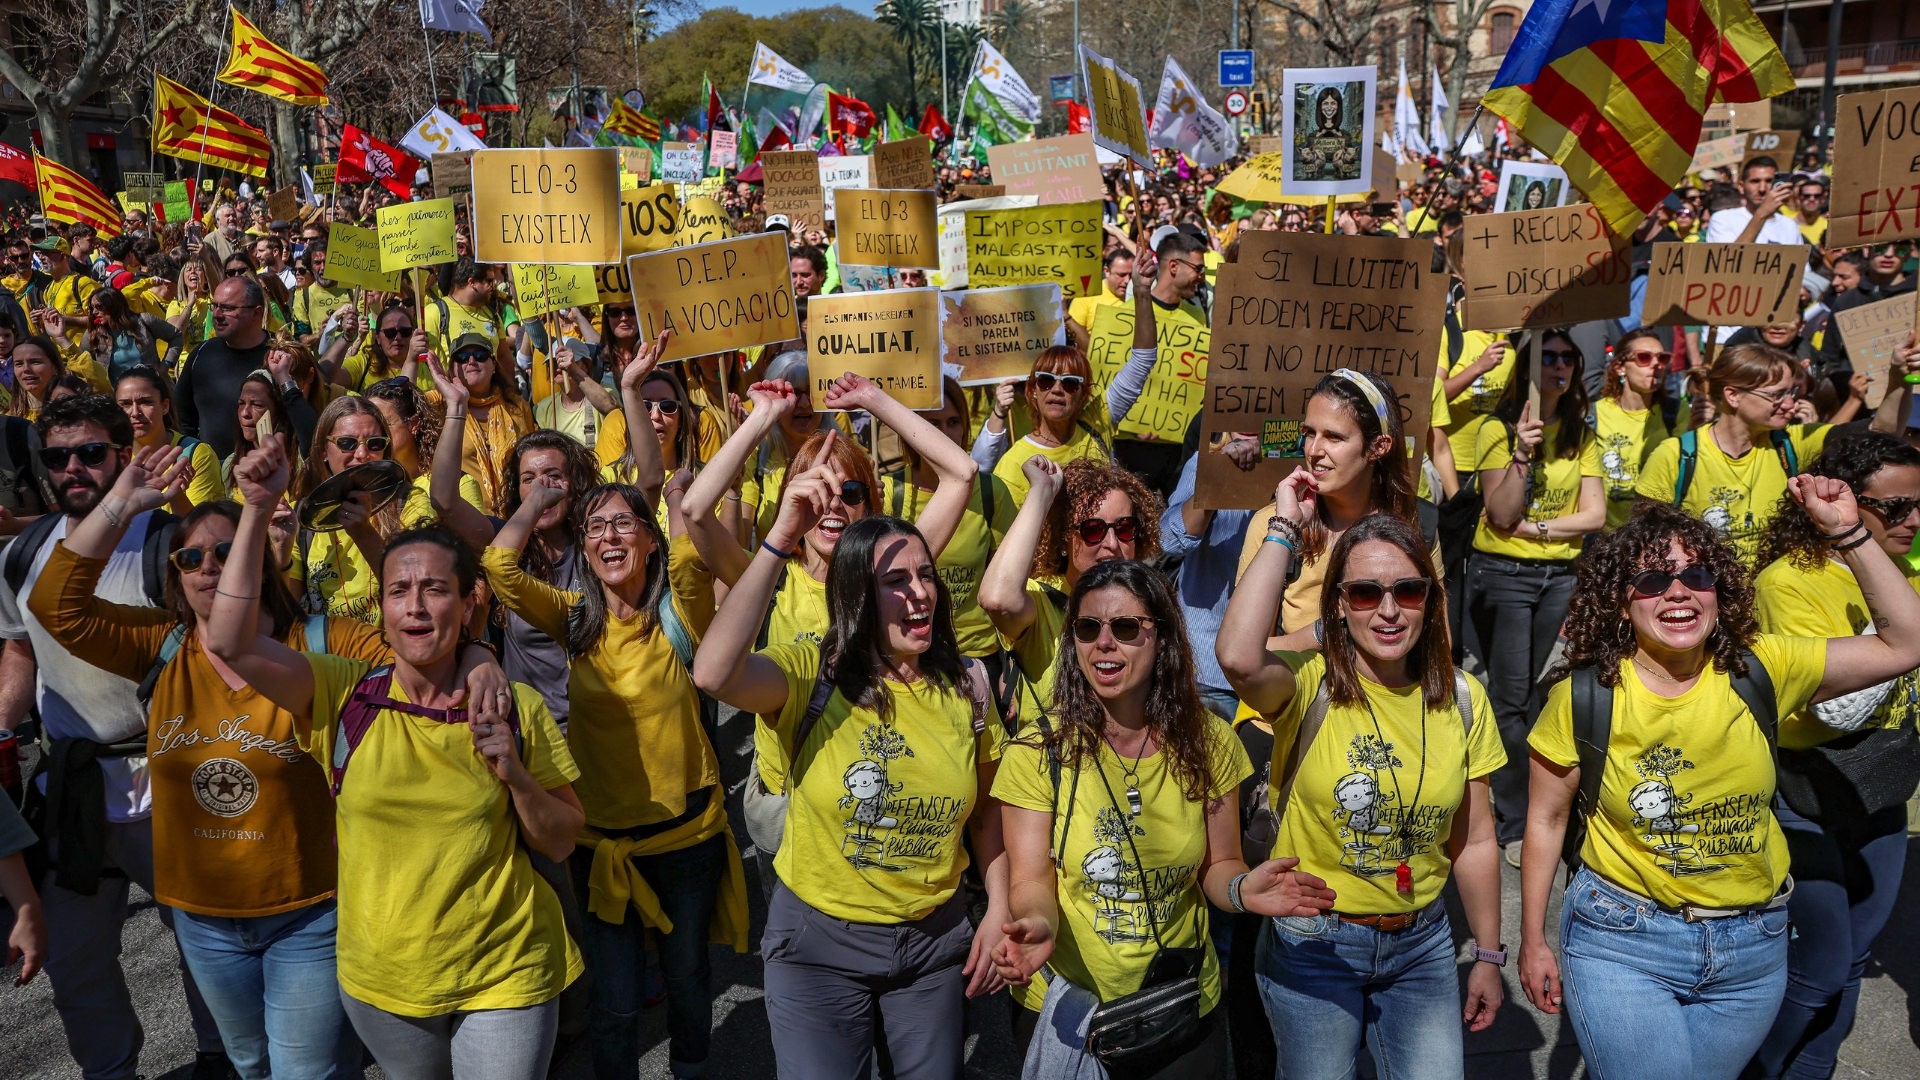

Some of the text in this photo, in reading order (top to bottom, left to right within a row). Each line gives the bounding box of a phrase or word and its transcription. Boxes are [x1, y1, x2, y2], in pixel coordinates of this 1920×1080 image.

[1103, 76, 1118, 100] EL
[1230, 99, 1243, 107] 30
[1752, 134, 1780, 150] NO
[763, 154, 780, 168] NO
[800, 154, 816, 167] HA
[901, 148, 914, 161] NO
[511, 163, 577, 194] EL 0-3
[825, 171, 837, 182] LA
[767, 186, 786, 198] QUE
[621, 193, 675, 236] IOS
[772, 200, 810, 211] AQUESTA
[861, 199, 877, 220] EL
[881, 200, 908, 221] 0-3
[380, 210, 402, 227] Les
[501, 213, 592, 244] EXISTEIX
[973, 216, 1097, 237] IMPOSTOS
[1513, 206, 1614, 245] RECURS
[335, 227, 358, 243] No
[856, 233, 919, 254] EXISTEIX
[389, 239, 420, 256] també
[976, 243, 1098, 261] MALGASTATS,
[676, 249, 746, 287] D.E.P.
[974, 262, 1065, 277] ALUMNES
[1255, 249, 1419, 290] SI LLUITEM
[1658, 246, 1684, 276] JA
[1753, 251, 1781, 275] HA
[319, 297, 340, 307] SOS
[1685, 282, 1763, 317] PROU
[647, 284, 790, 341] LA VOCACIÓ
[824, 309, 914, 324] ELS INFANTS MEREIXEN
[963, 310, 1036, 327] SI NOSALTRES
[1228, 296, 1424, 336] PODEM PERDRE,
[1521, 302, 1564, 321] 20M
[1840, 301, 1917, 333] DEFENSE
[817, 330, 919, 355] QUALITAT,
[982, 326, 1019, 340] PAREM
[1108, 312, 1210, 354] SNSE
[958, 338, 1050, 357] EL SISTEMA CAU
[1219, 343, 1419, 378] SI NO LLUITEM
[887, 374, 927, 390] TAMBÉ.
[1158, 378, 1188, 406] HA
[1214, 386, 1286, 415] ESTEM
[1265, 420, 1298, 432] DALMAU
[152, 714, 304, 764] Los Angeles
[197, 763, 252, 784] ROCK STAR
[886, 795, 961, 822] DEFENSEM
[1682, 794, 1759, 821] DEFENSEM
[194, 828, 265, 840] CALIFORNIA
